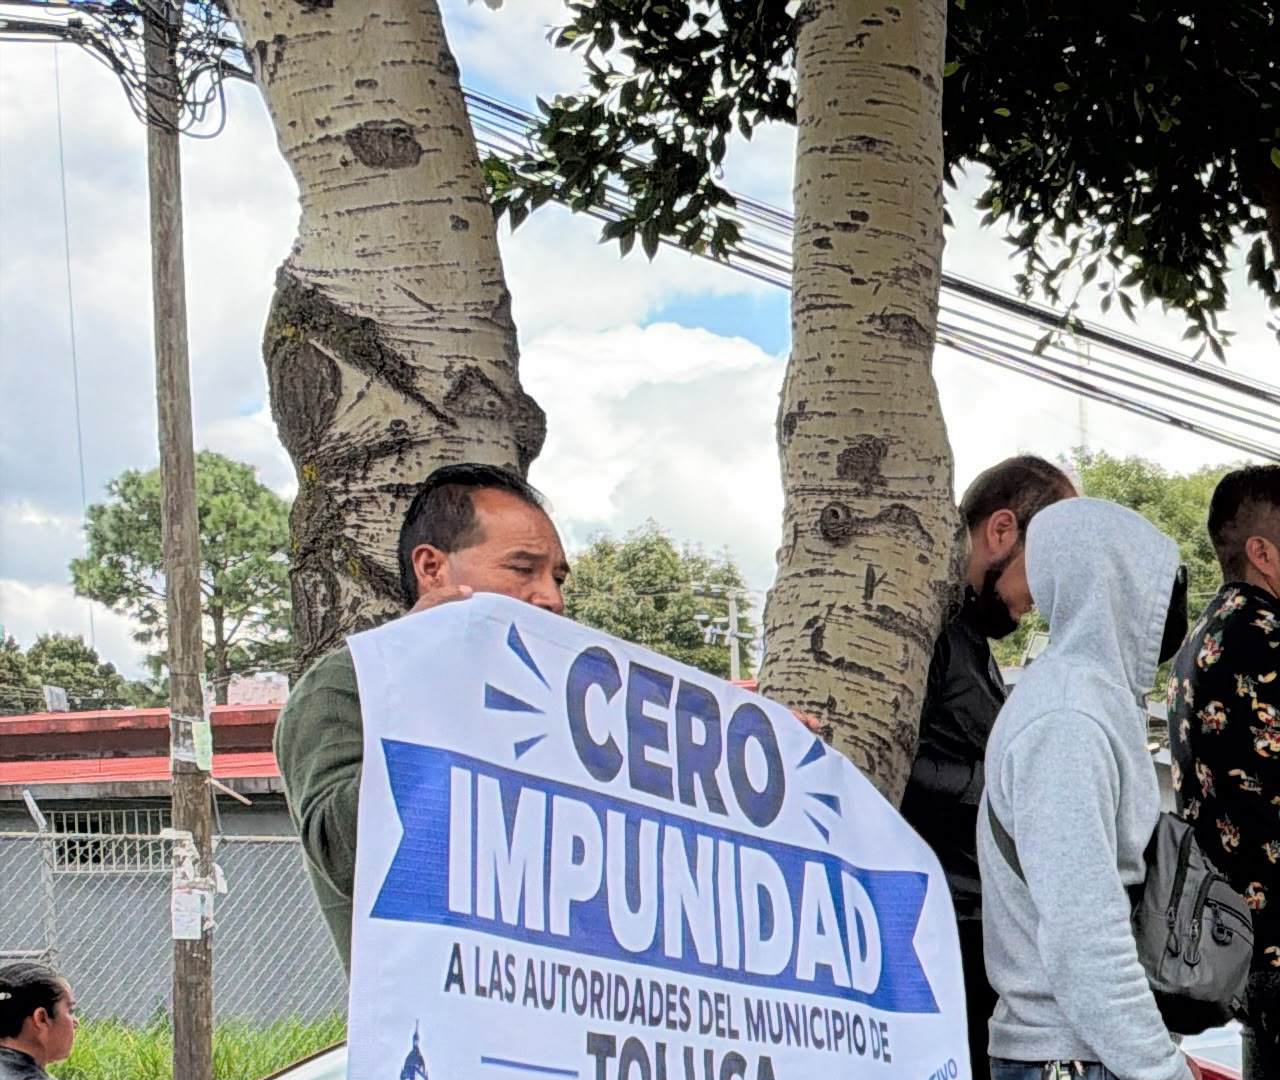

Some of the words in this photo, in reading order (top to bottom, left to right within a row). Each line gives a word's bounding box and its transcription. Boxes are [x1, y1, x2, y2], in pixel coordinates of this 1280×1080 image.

[566, 645, 785, 828] CERO
[448, 766, 881, 995] IMPUNIDAD
[444, 942, 467, 995] A
[474, 946, 516, 1004] LAS
[523, 958, 691, 1034] AUTORIDADES
[699, 988, 738, 1040] DEL
[745, 997, 866, 1056] MUNICIPIO
[871, 1022, 892, 1063] DE
